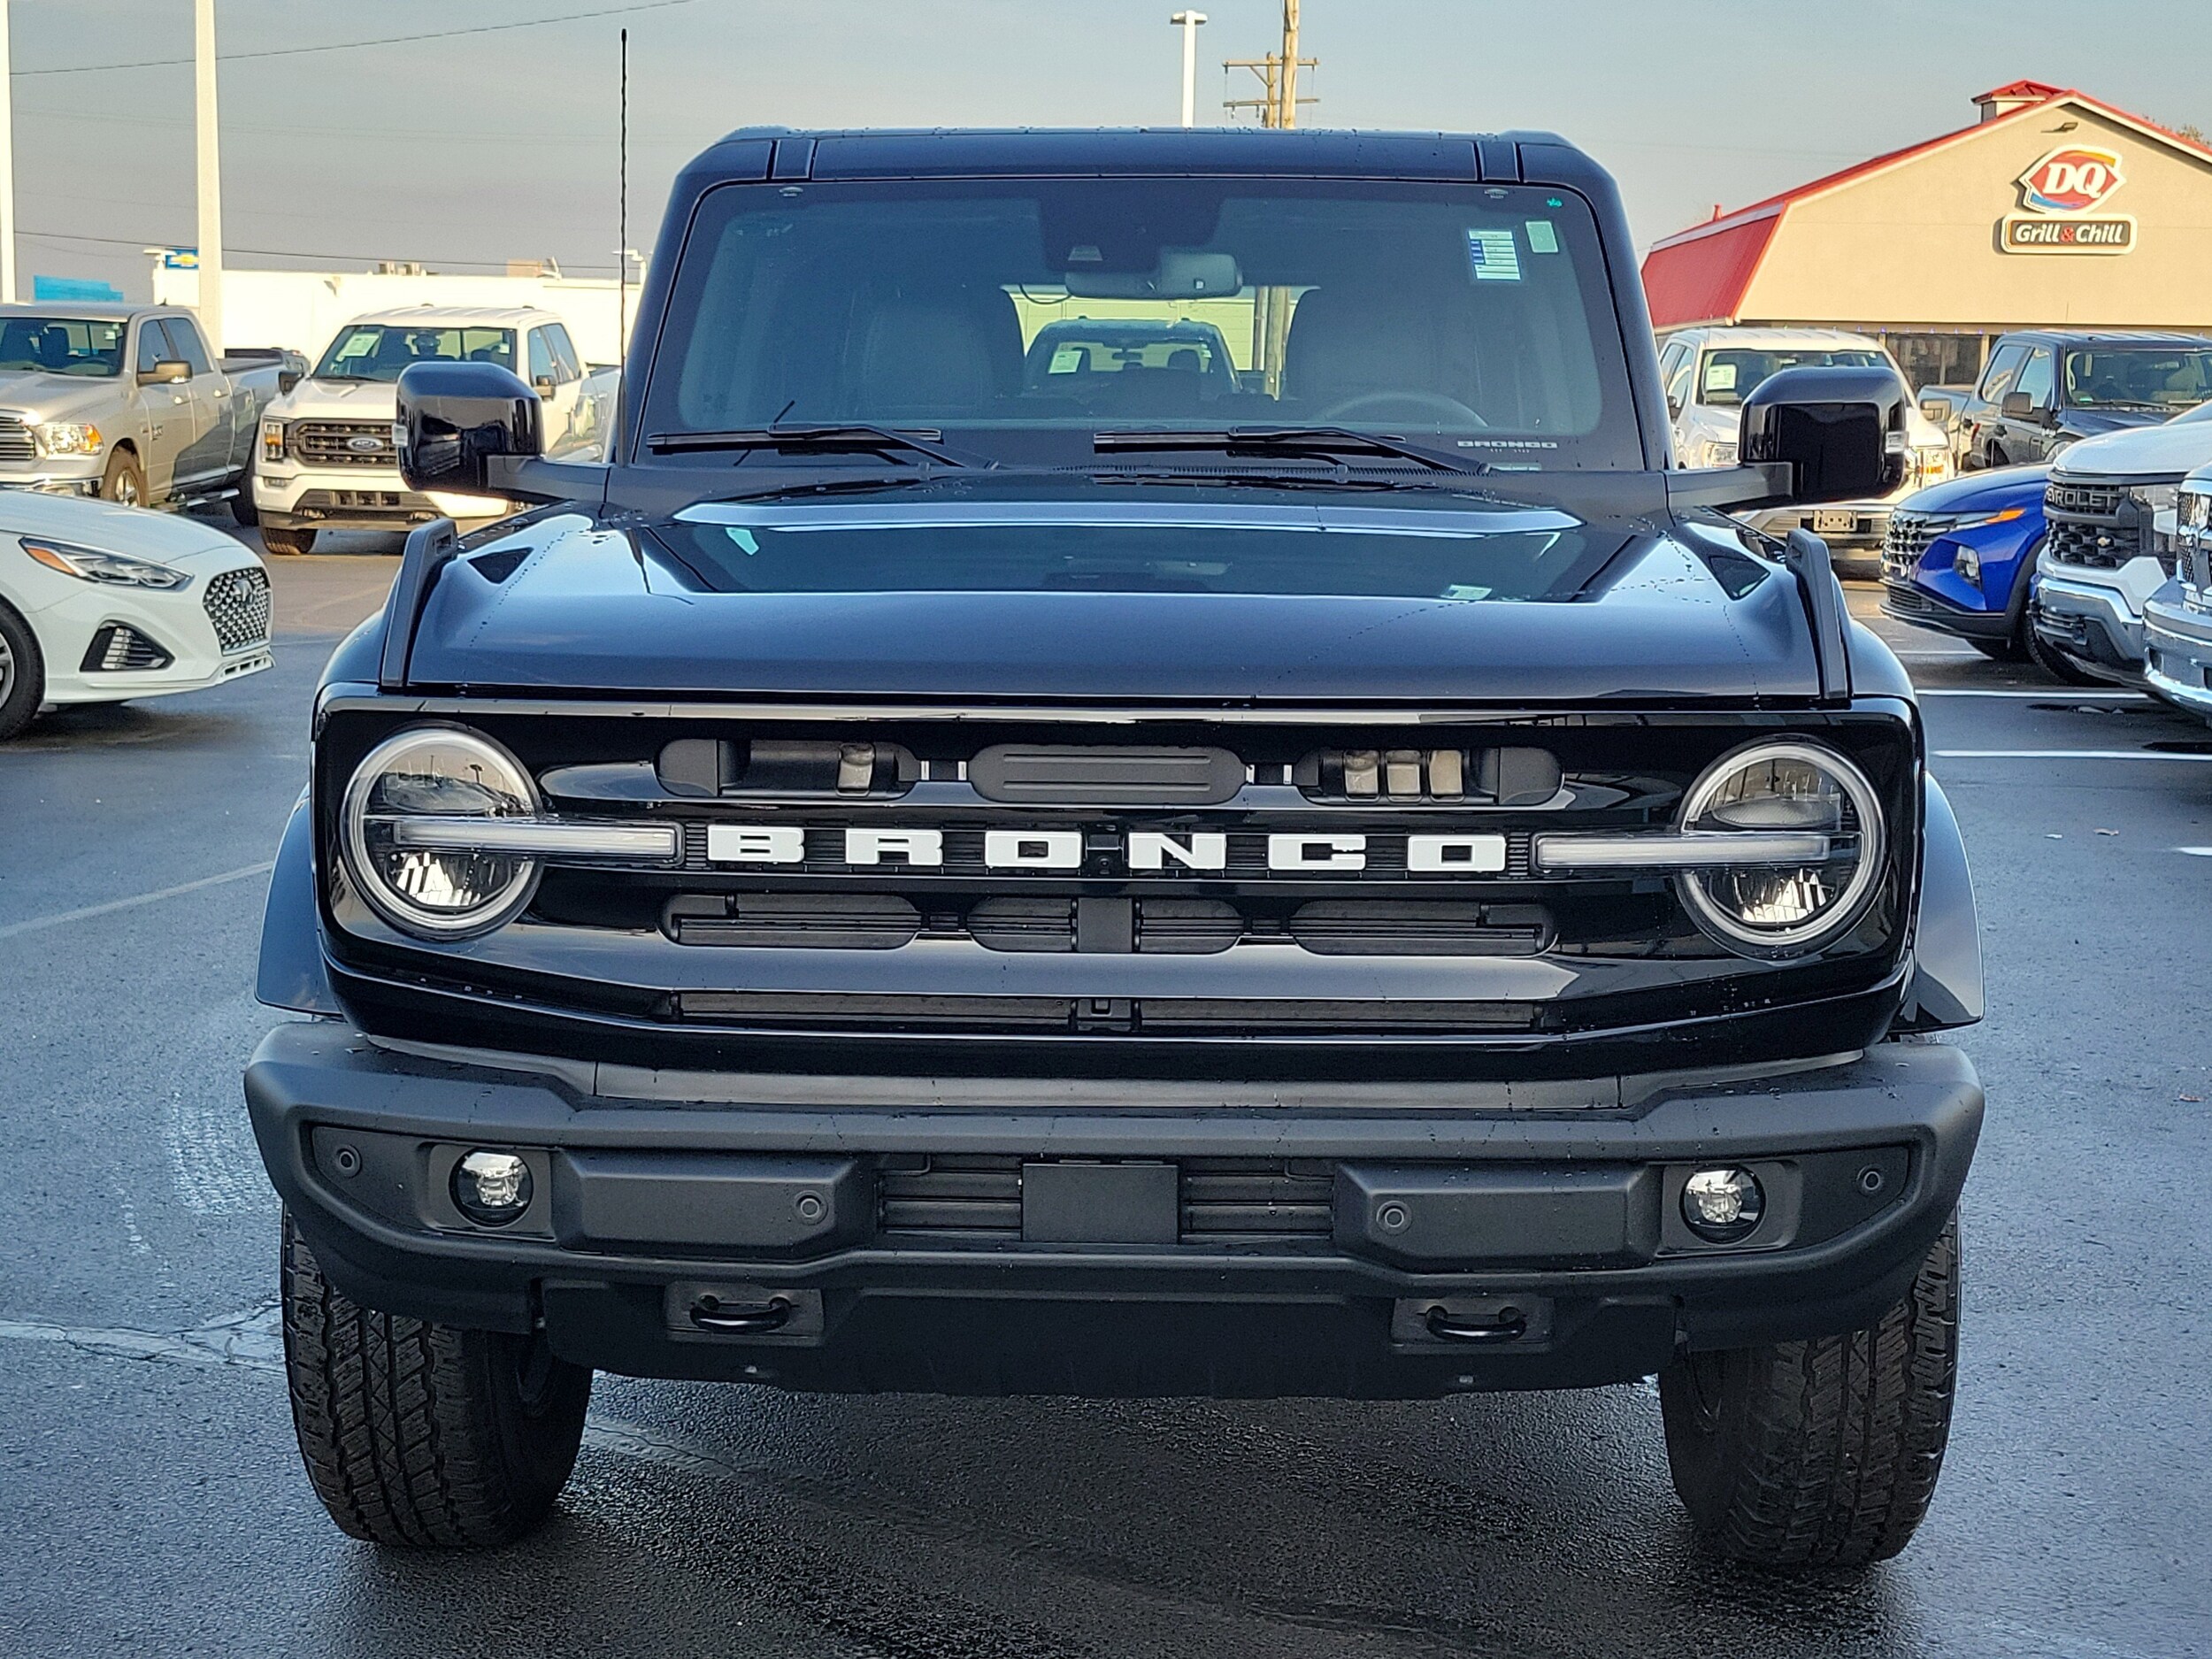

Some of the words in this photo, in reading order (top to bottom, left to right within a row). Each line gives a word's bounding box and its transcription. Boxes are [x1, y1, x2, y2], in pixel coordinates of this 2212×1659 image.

[2042, 162, 2108, 199] DQ
[2016, 224, 2060, 242] Grill
[2076, 223, 2124, 243] Chill
[707, 824, 1508, 872] BRONCO
